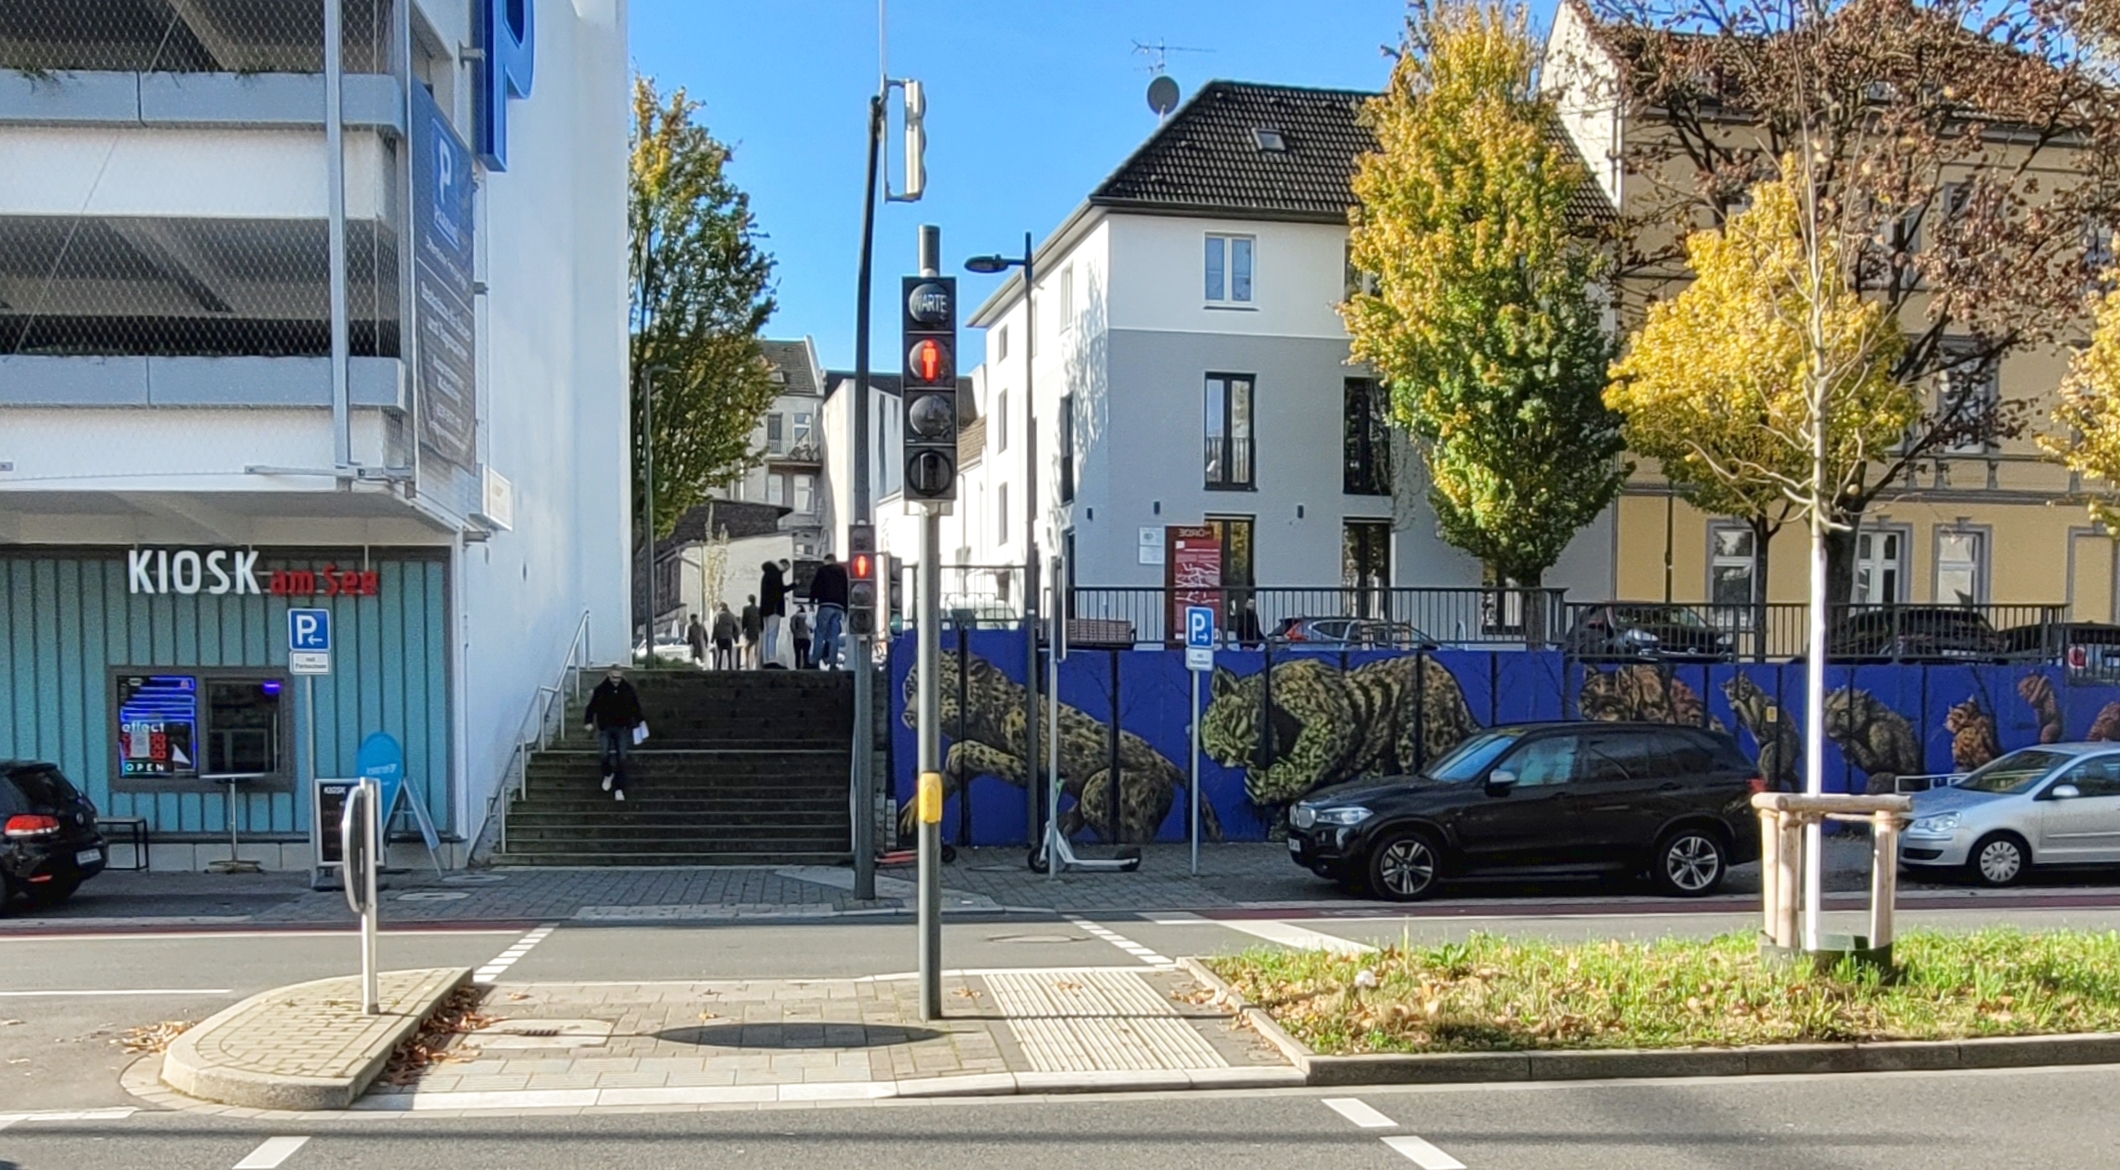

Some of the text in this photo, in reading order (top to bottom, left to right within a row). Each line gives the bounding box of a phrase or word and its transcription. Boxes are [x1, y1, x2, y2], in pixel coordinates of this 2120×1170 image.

[489, 0, 534, 172] P
[439, 137, 452, 204] P
[912, 293, 948, 313] WARTE
[128, 549, 378, 596] KIOSK am See
[296, 614, 317, 646] P
[1191, 612, 1206, 642] P
[125, 763, 165, 772] OPEN
